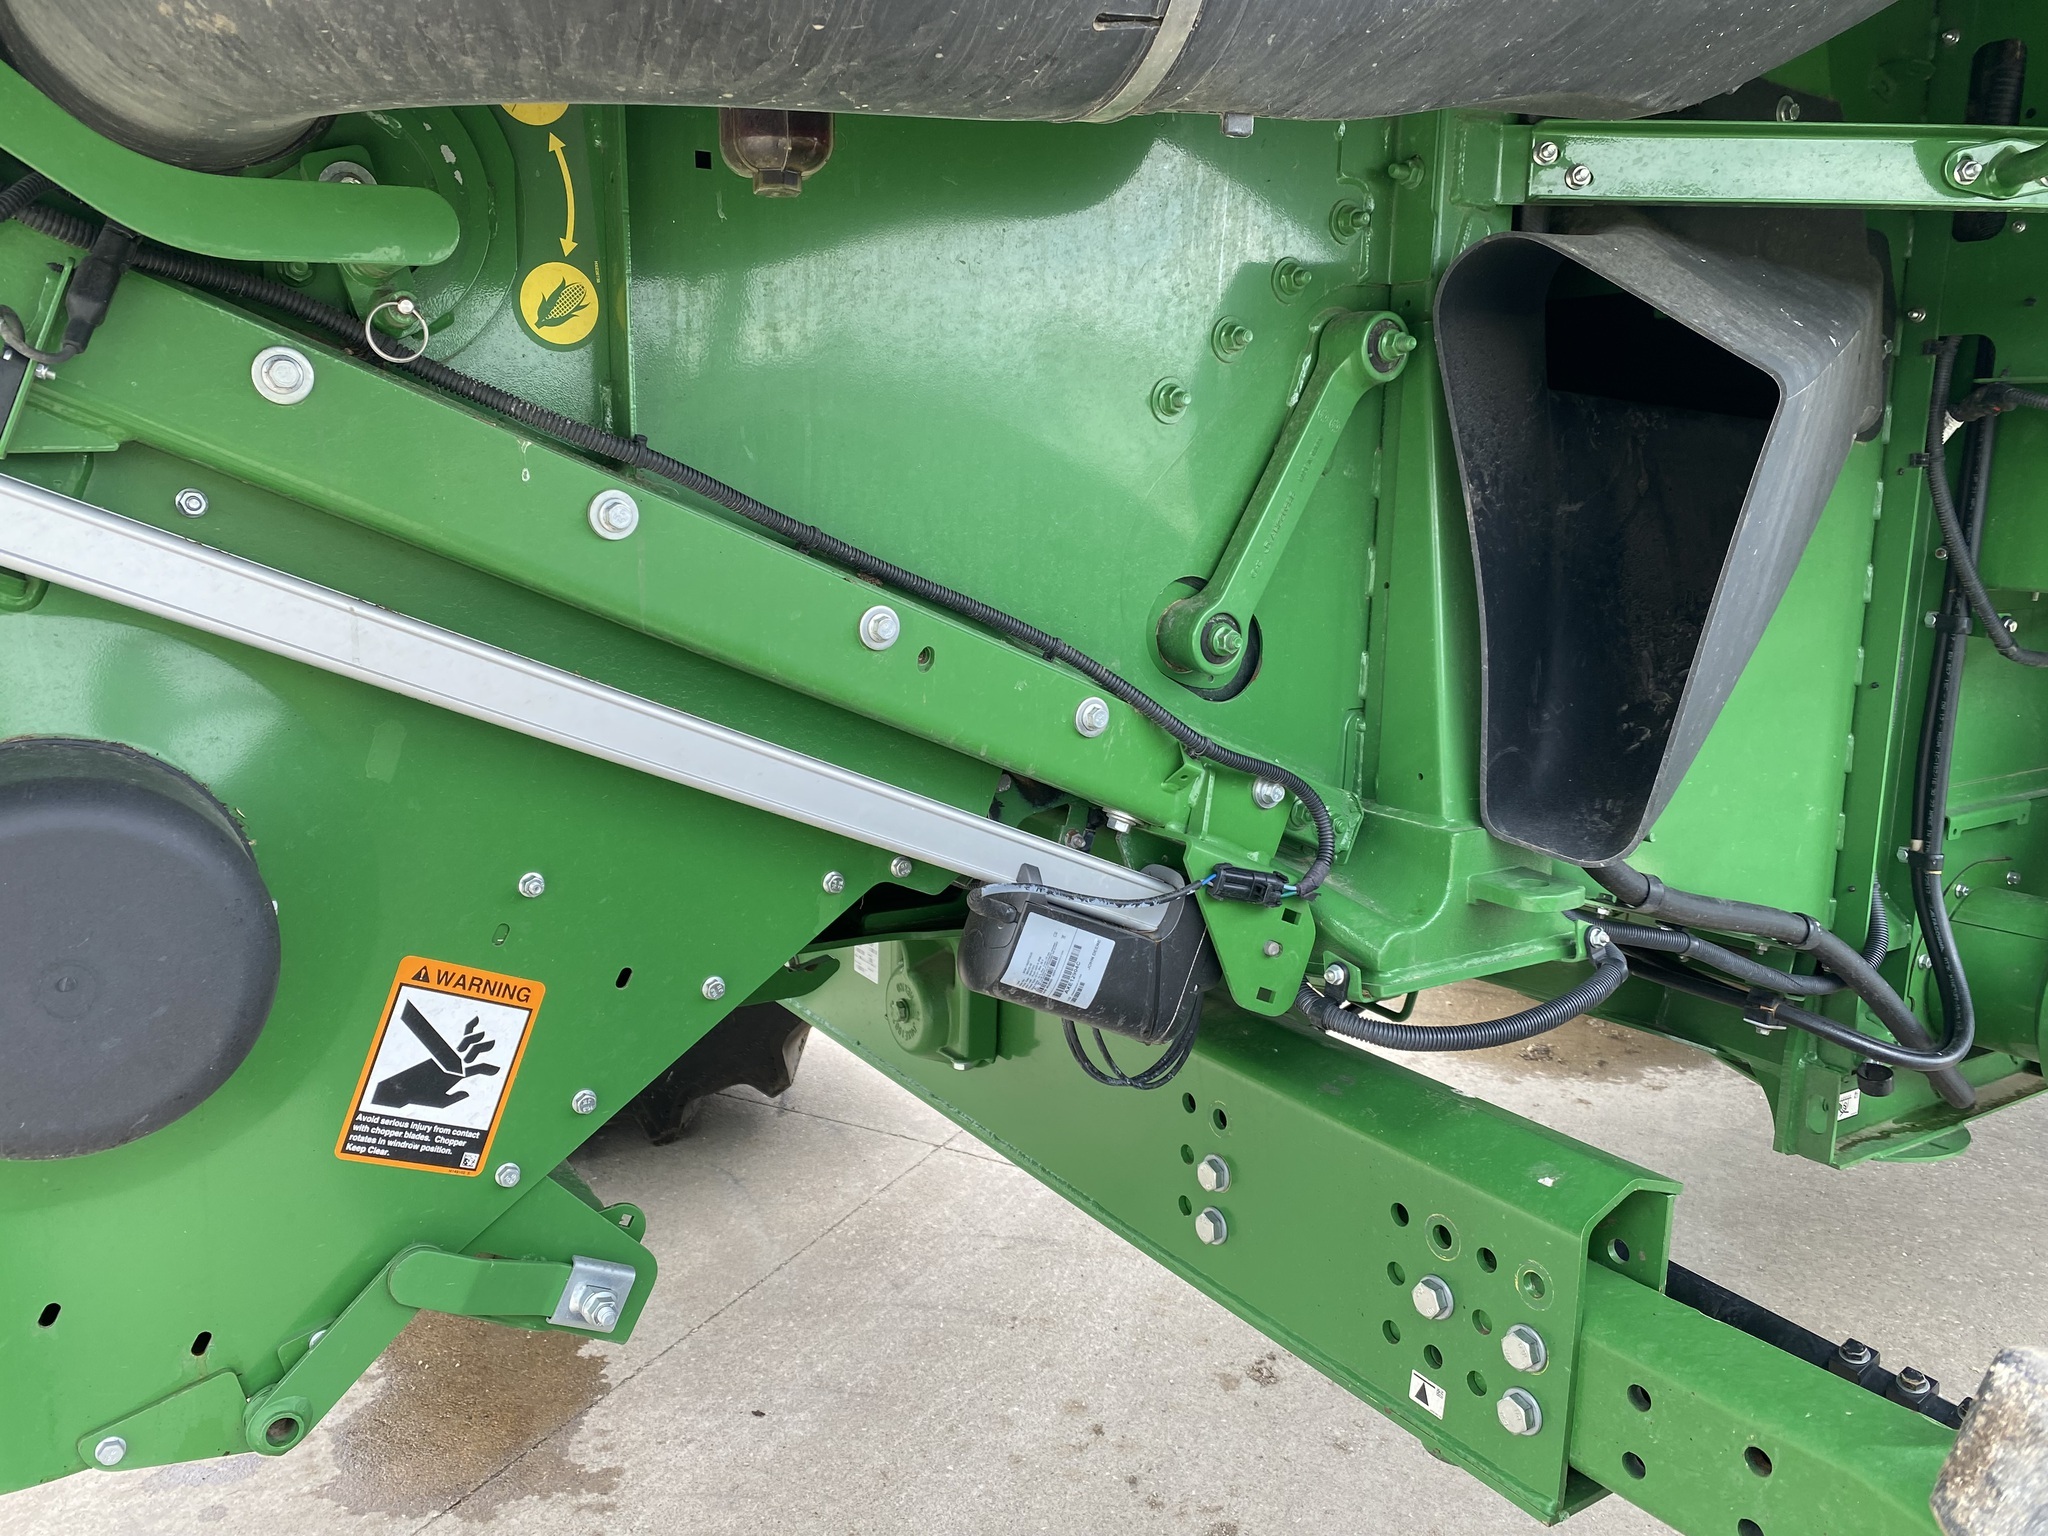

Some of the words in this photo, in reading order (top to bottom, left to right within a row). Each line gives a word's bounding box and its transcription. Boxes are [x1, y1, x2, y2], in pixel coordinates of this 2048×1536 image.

[436, 969, 532, 1003] WARNING
[353, 1124, 370, 1132] with
[370, 1126, 403, 1138] chopper
[403, 1131, 431, 1141] blades.
[434, 1136, 467, 1147] Chopper
[355, 1113, 380, 1123] Avoid
[380, 1117, 409, 1128] serious
[410, 1122, 432, 1133] injury
[433, 1125, 450, 1135] from
[452, 1129, 480, 1139] contact
[345, 1143, 366, 1154] Keep
[368, 1146, 390, 1156] Clear.
[349, 1134, 377, 1144] rotates
[387, 1139, 420, 1150] windrow
[420, 1144, 452, 1155] position.
